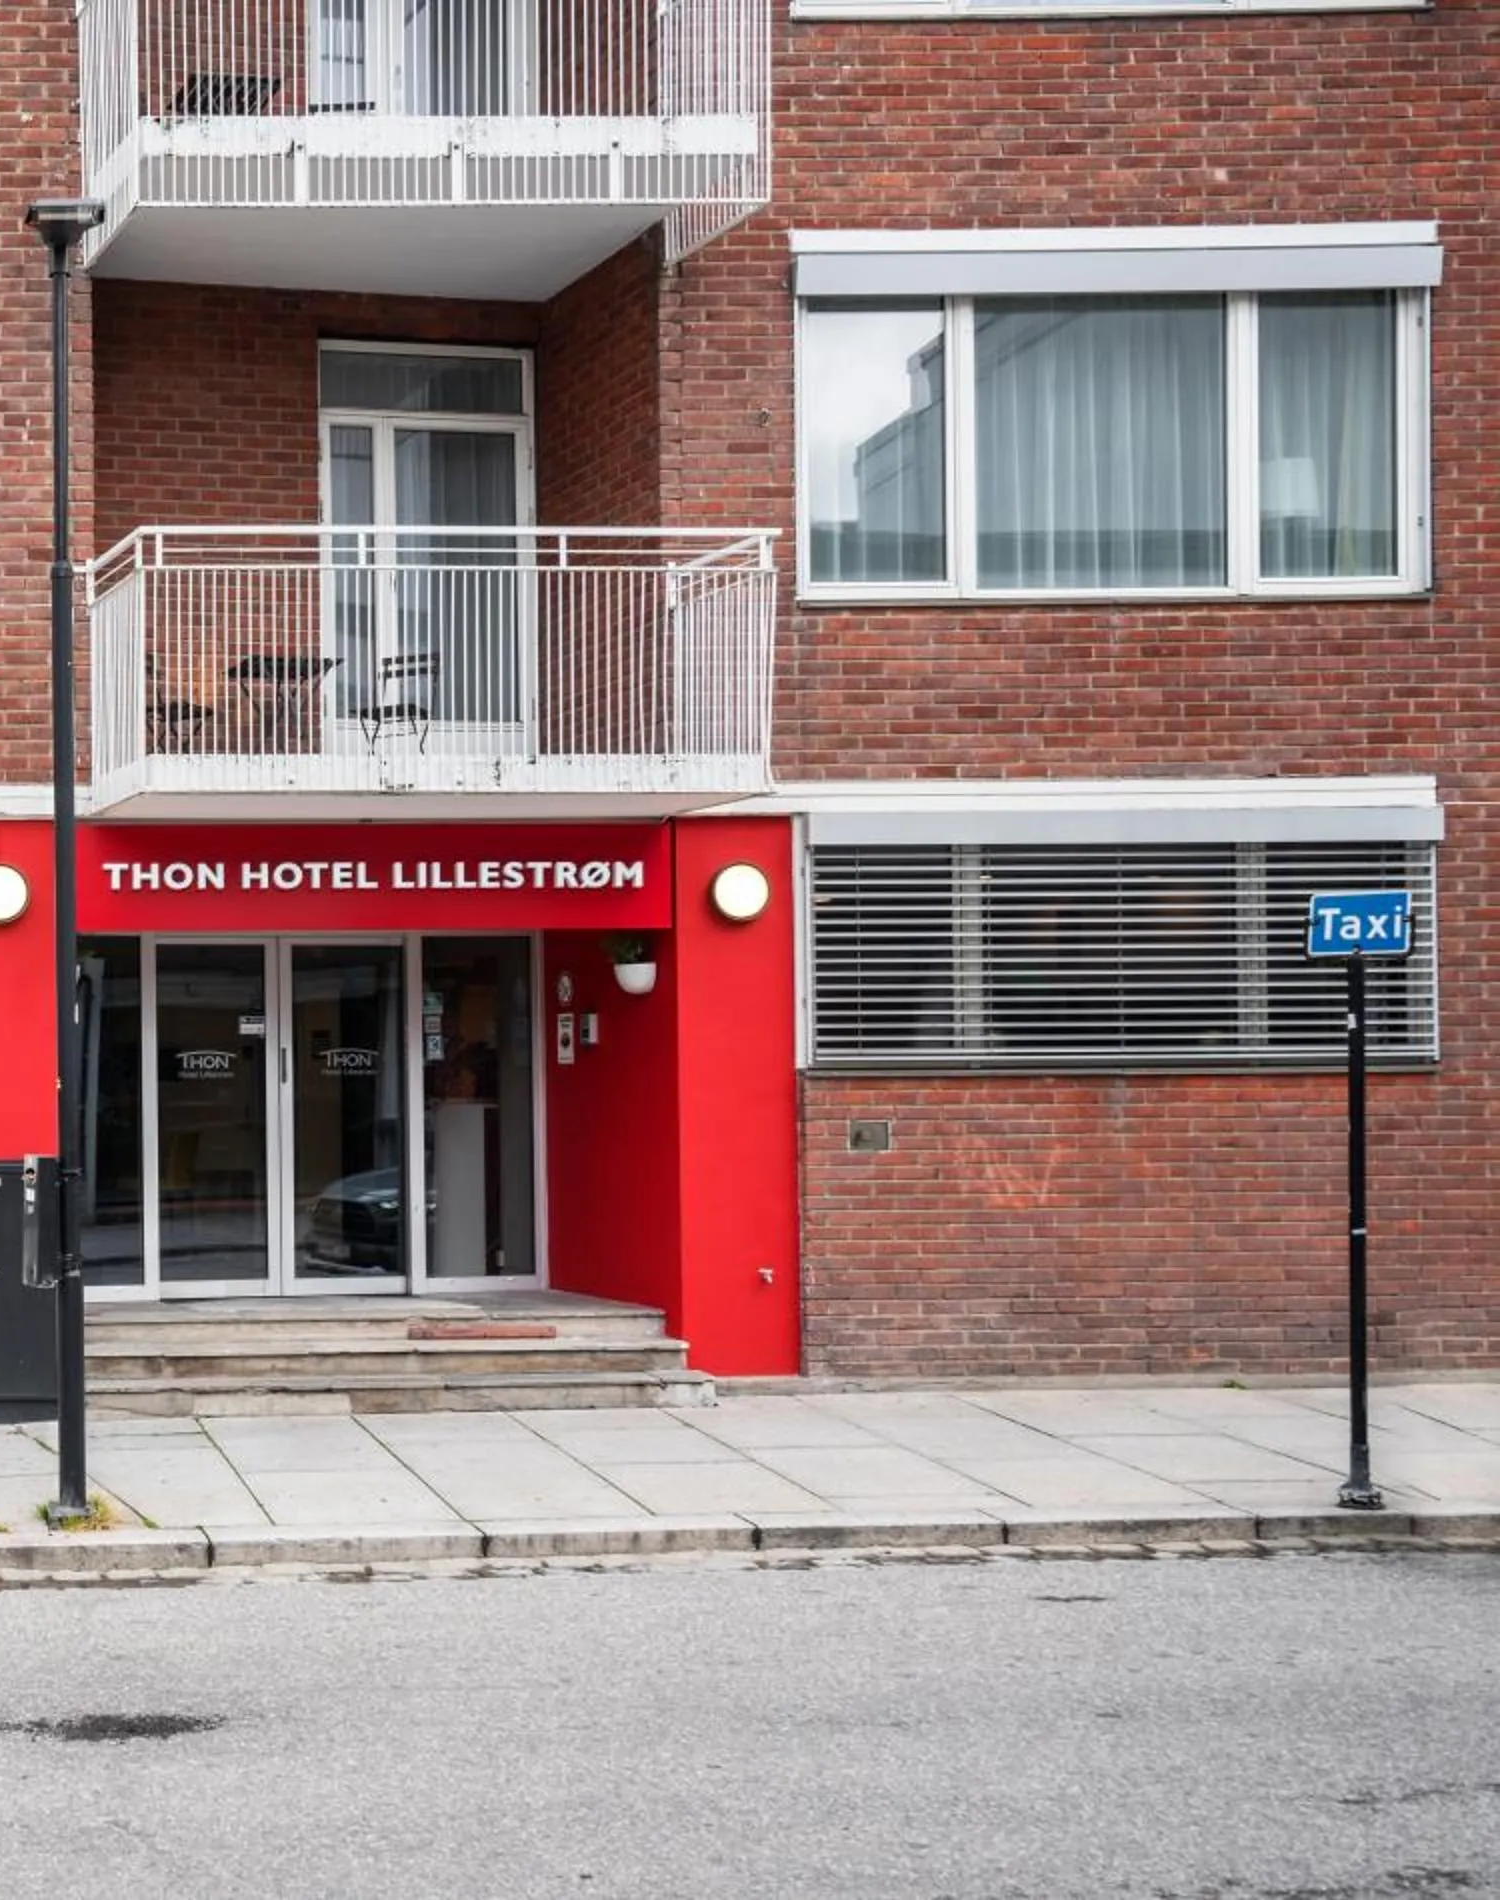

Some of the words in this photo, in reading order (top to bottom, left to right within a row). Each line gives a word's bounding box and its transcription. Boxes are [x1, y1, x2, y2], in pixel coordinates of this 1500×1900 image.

[102, 862, 225, 890] THON
[241, 862, 379, 890] HOTEL
[392, 861, 645, 889] LILLESTRØM
[1318, 905, 1403, 941] Taxi
[176, 1050, 236, 1069] THON
[320, 1047, 379, 1067] THON
